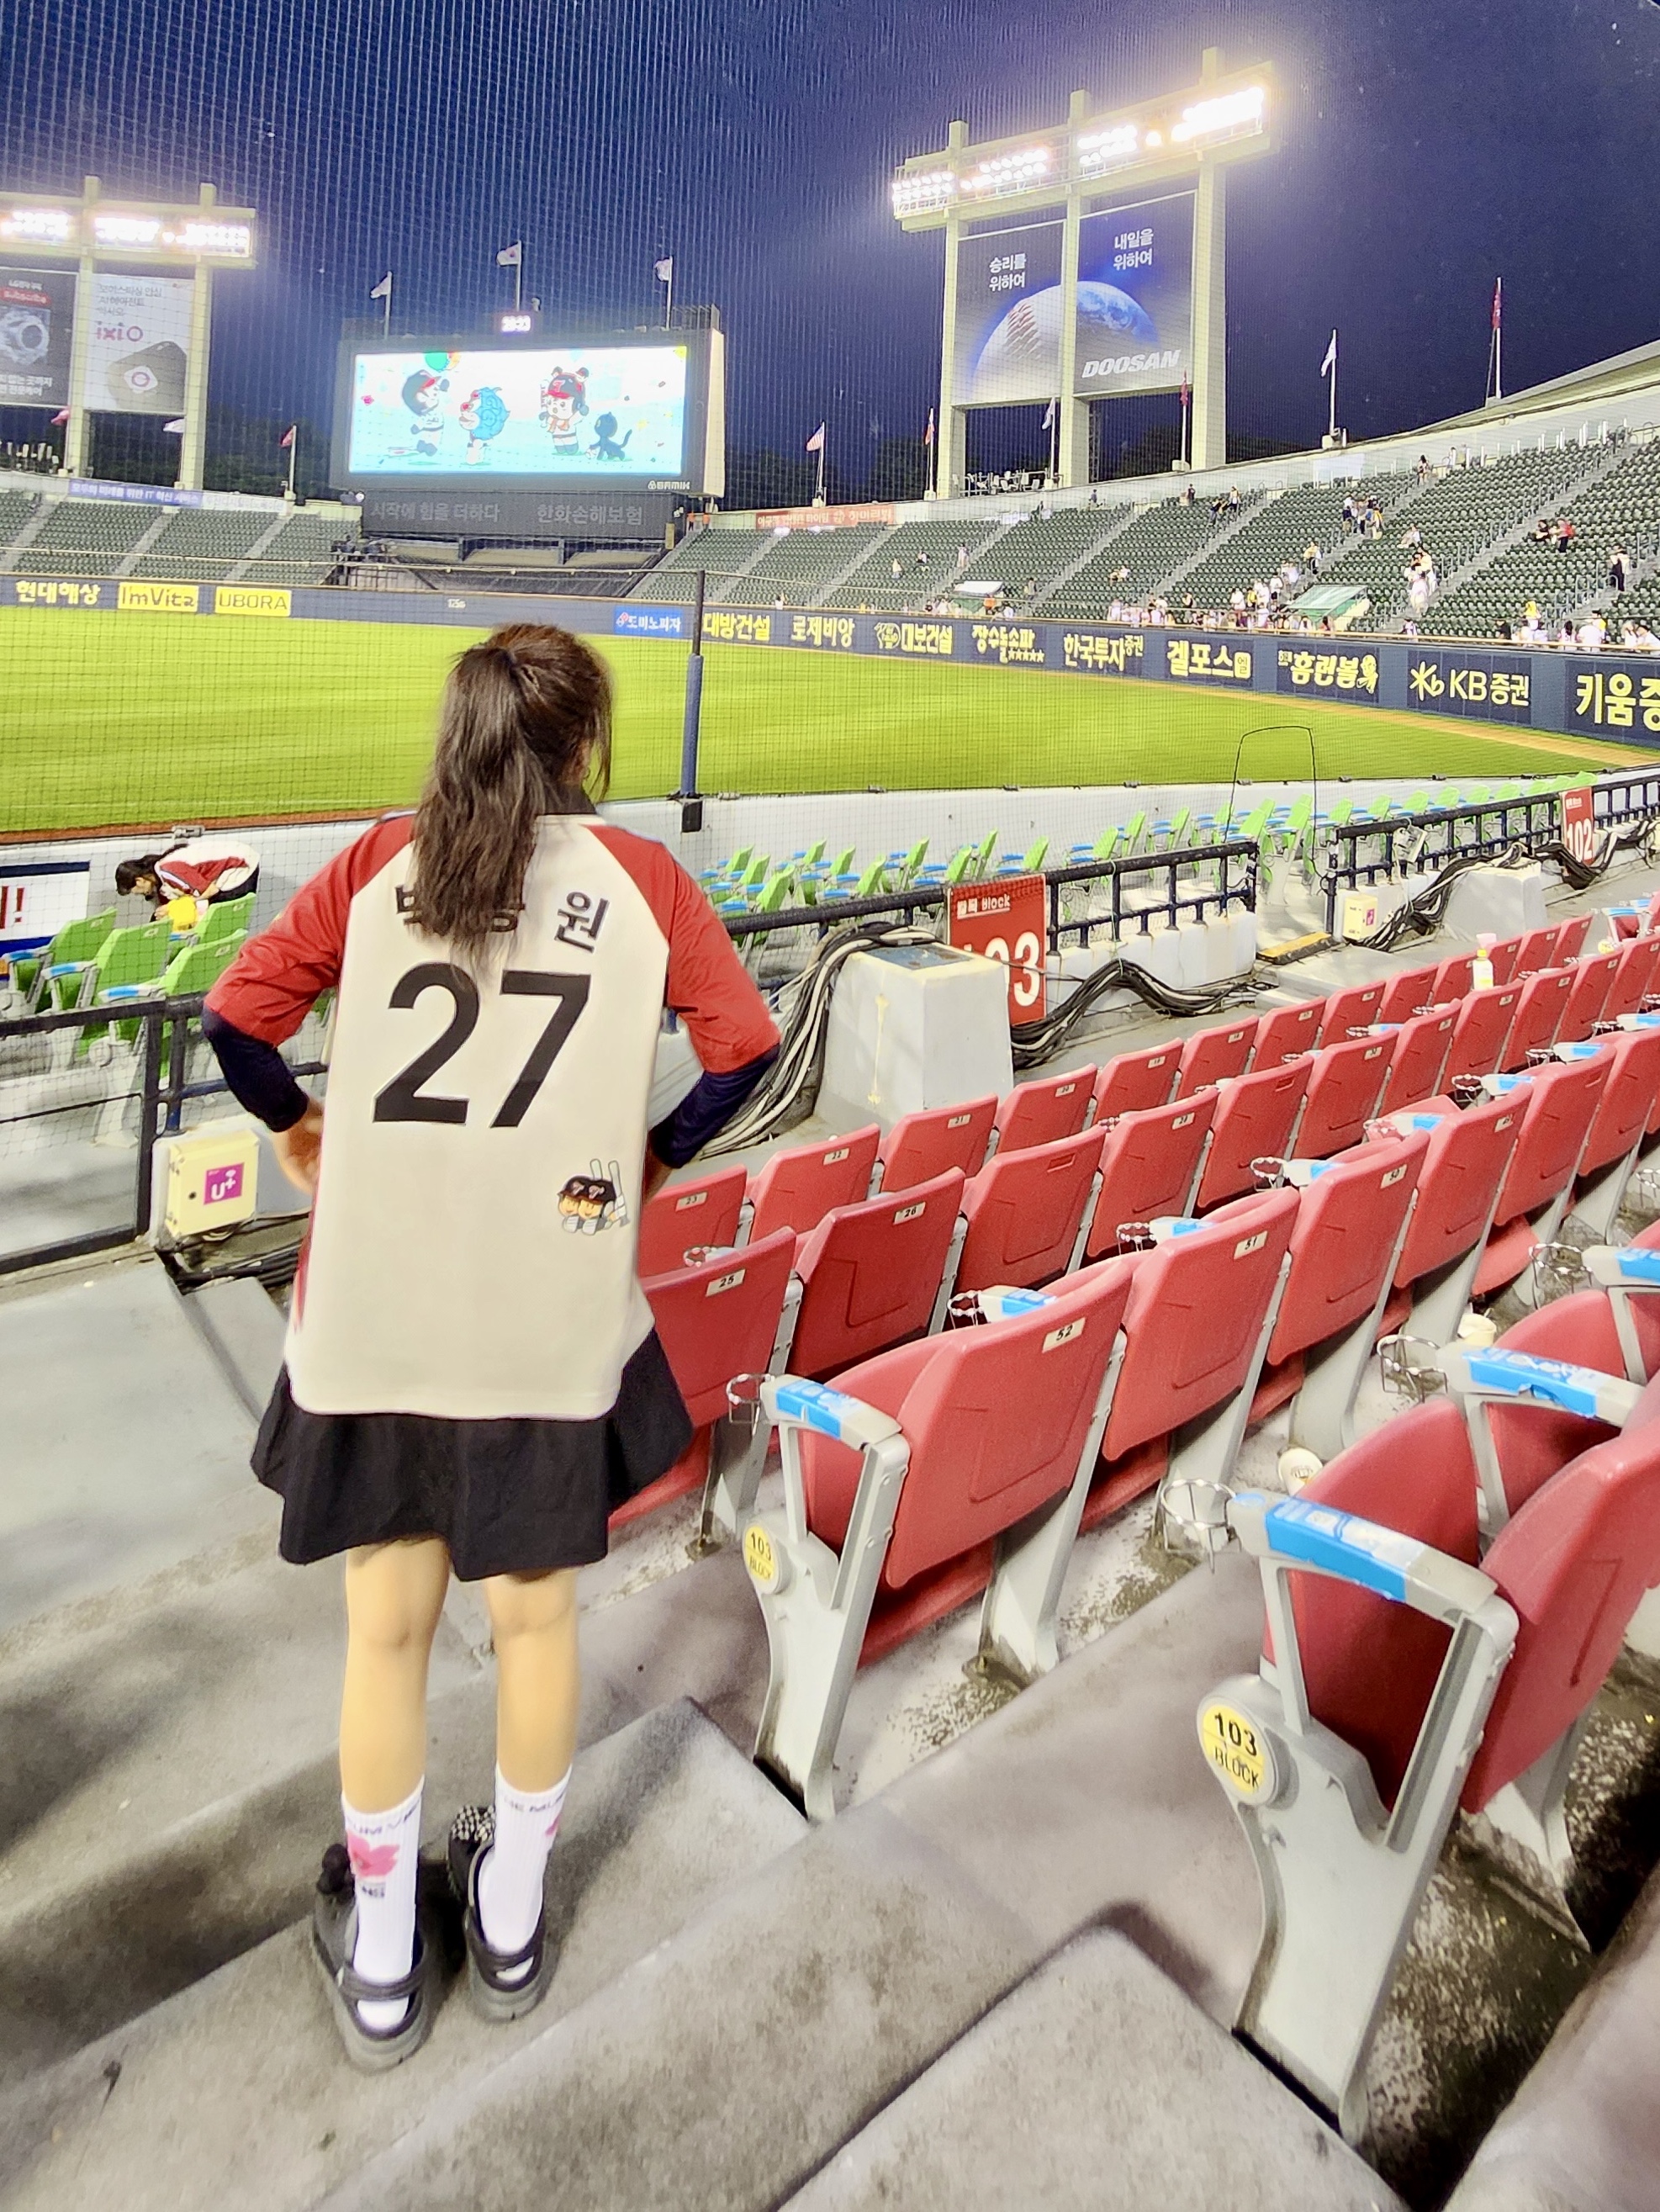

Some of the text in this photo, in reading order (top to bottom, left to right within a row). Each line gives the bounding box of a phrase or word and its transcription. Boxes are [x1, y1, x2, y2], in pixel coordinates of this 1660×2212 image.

[1113, 228, 1155, 251] 내일을
[989, 253, 1027, 273] 승리를
[1113, 248, 1153, 271] 위하여
[989, 272, 1026, 292] 위하여
[1081, 349, 1182, 378] DOOSAN
[145, 489, 154, 500] IT
[452, 503, 500, 522] 더하다
[537, 505, 643, 526] 한화손해보험
[15, 580, 101, 606] 현대해상
[218, 592, 289, 611] UBORA
[628, 615, 682, 632] 도미노피자
[703, 612, 771, 642] 대방건설
[790, 615, 856, 648] 로제비앙
[901, 623, 954, 655] 대보건설
[1290, 651, 1359, 689] 홈런볼
[1449, 669, 1530, 706] KB증권
[1567, 818, 1593, 863] 102
[373, 961, 591, 1129] 27
[832, 1151, 843, 1160] 22
[686, 1196, 698, 1205] 23
[904, 1206, 917, 1219] 26
[1245, 1236, 1258, 1252] 51
[719, 1274, 734, 1289] 25
[1056, 1324, 1074, 1342] 52
[750, 1532, 772, 1562] 103
[1214, 1712, 1258, 1757] 103
[1214, 1746, 1261, 1789] BLOCK
